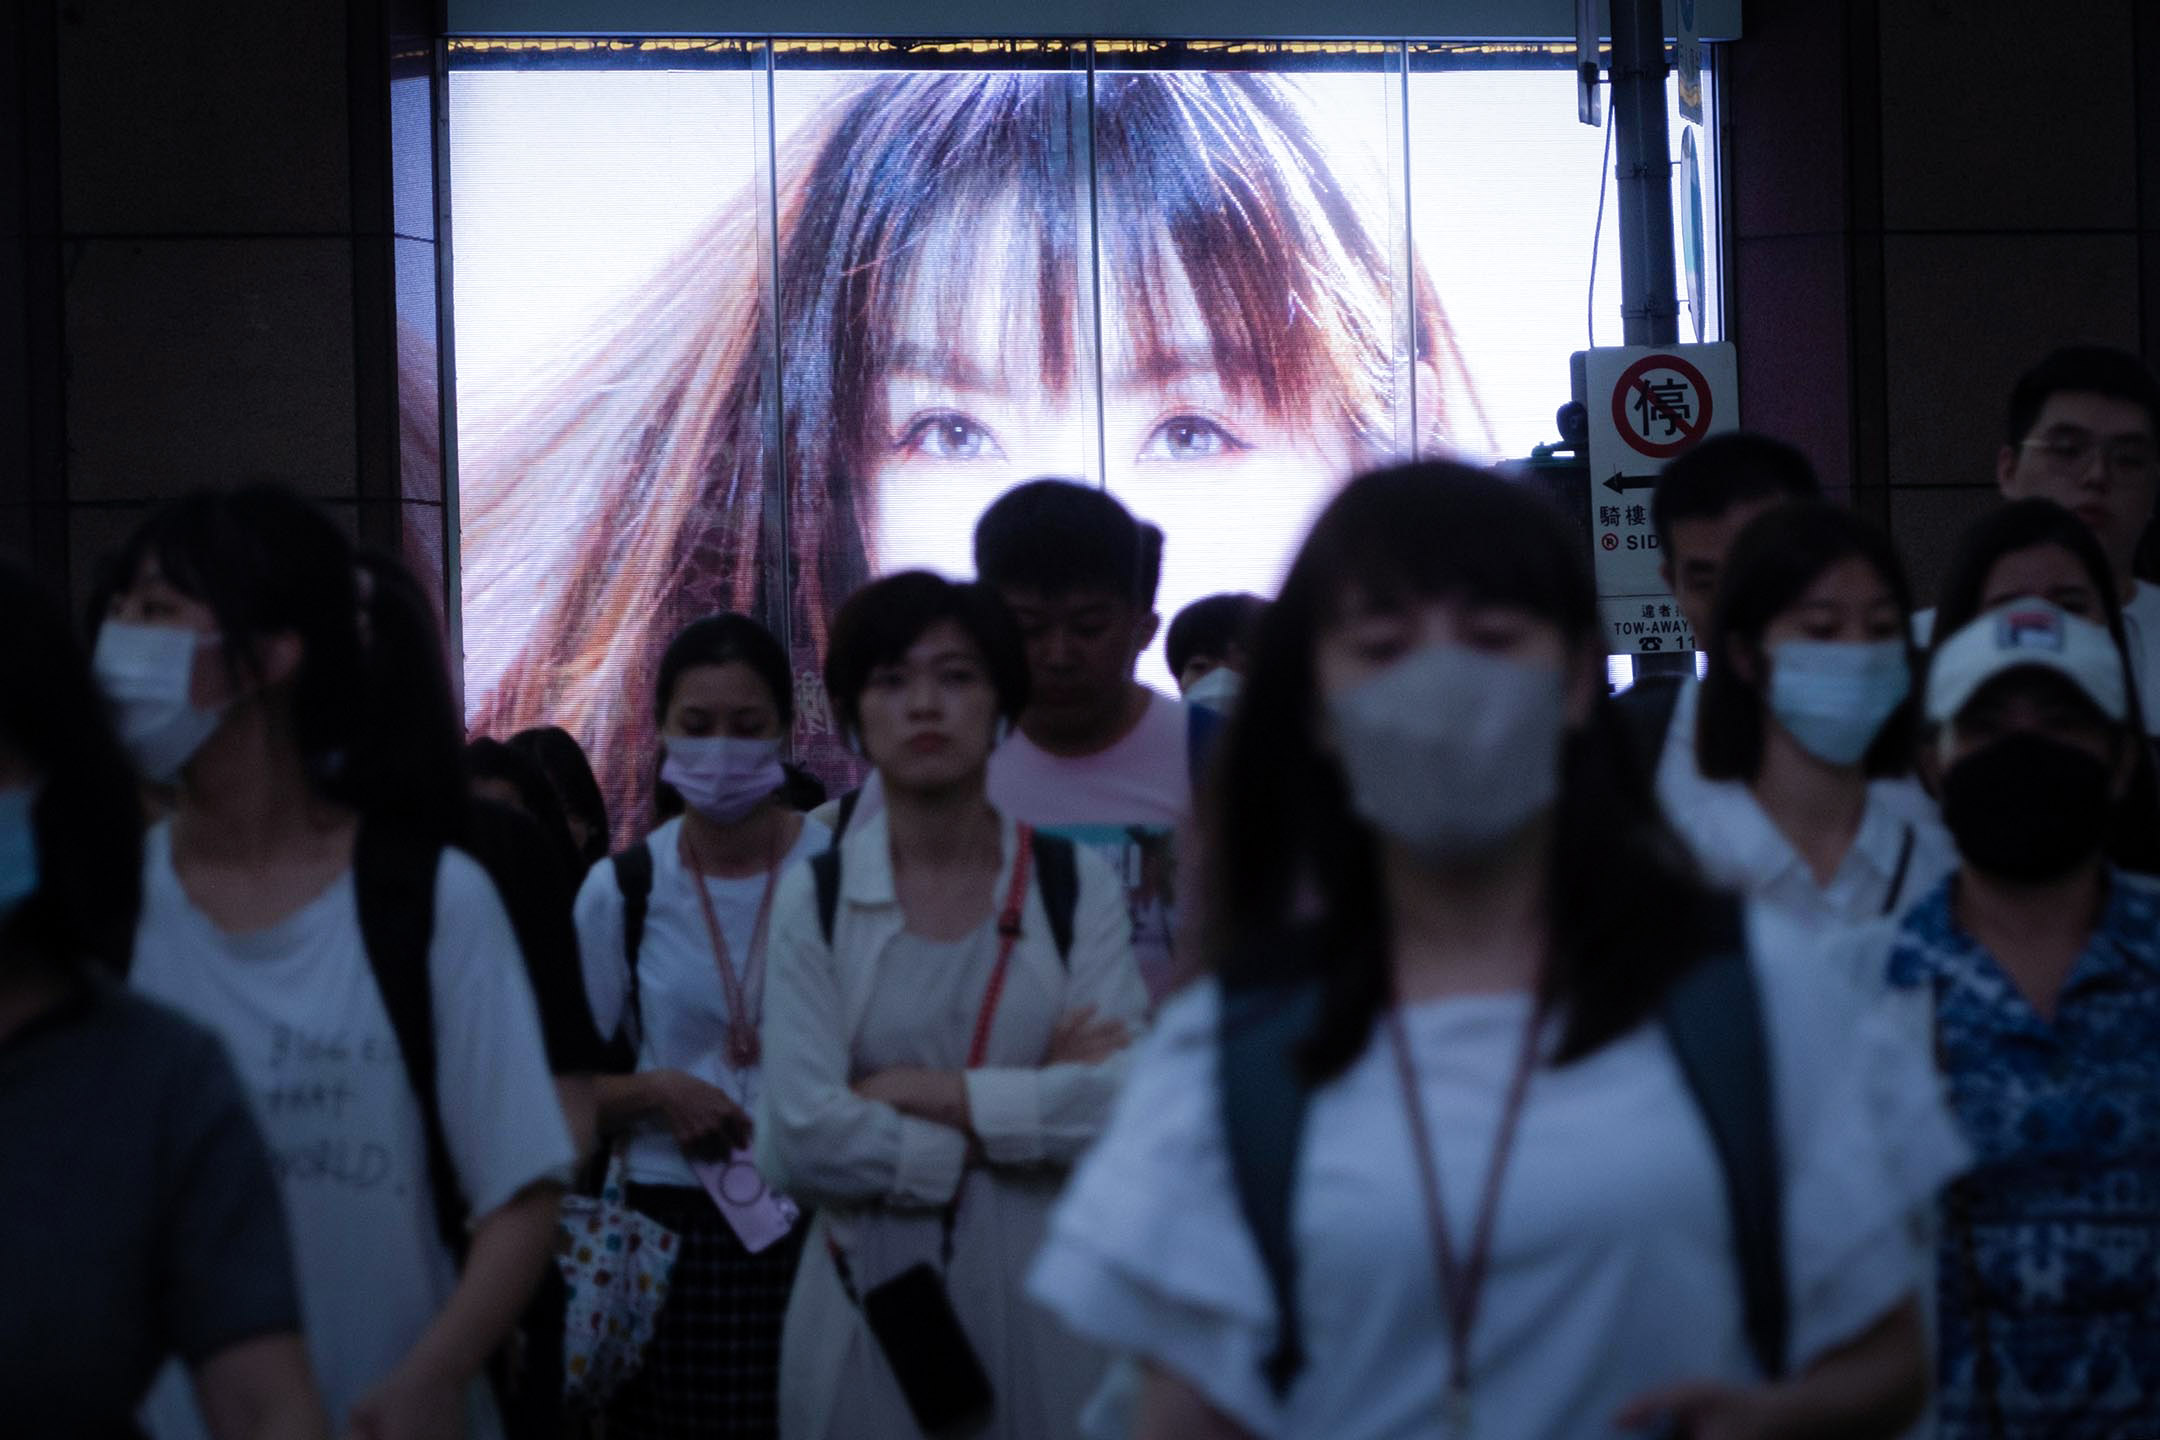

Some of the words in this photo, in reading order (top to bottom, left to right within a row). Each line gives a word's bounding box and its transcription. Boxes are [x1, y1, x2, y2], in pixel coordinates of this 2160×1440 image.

[1633, 377, 1691, 436] 停
[1600, 505, 1647, 527] 騎樓
[1627, 535, 1662, 550] SID
[1614, 620, 1689, 635] TOW-AWAY
